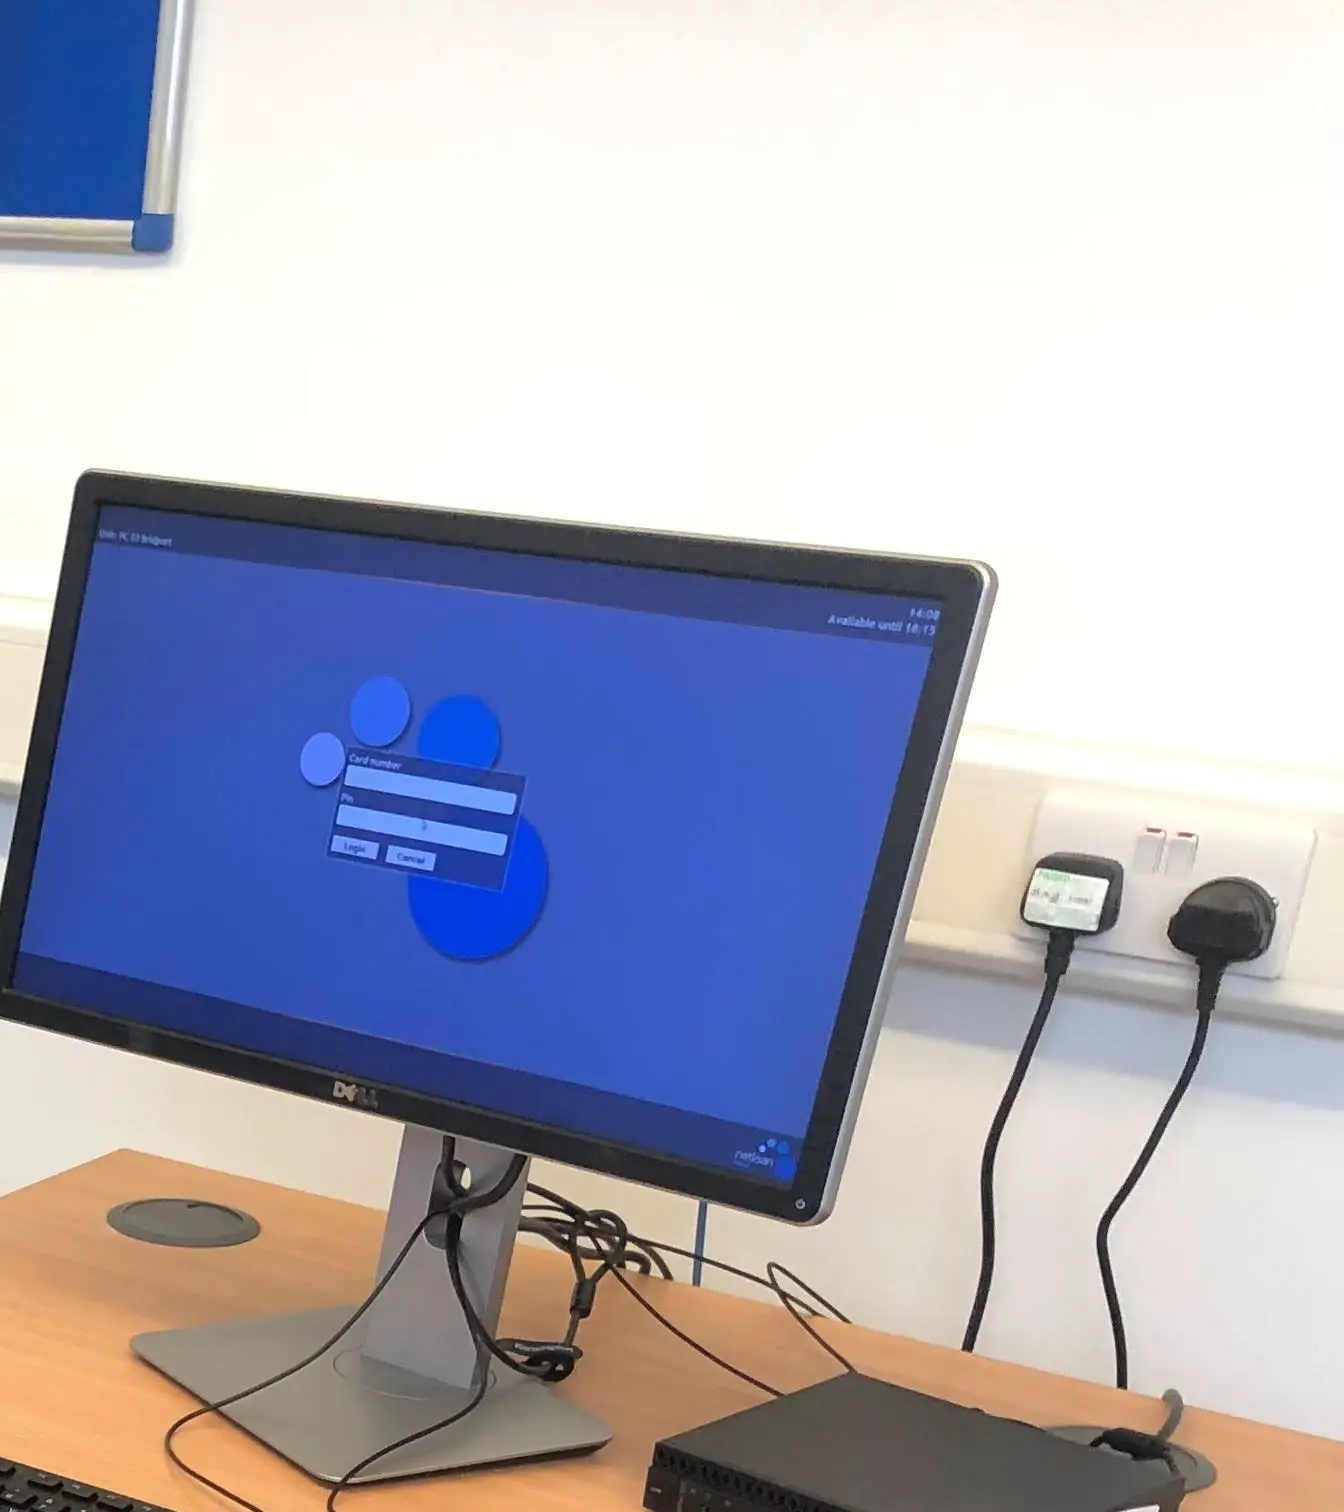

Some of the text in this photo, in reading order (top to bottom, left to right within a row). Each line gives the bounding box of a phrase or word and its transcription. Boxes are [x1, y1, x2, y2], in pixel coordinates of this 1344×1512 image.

[827, 614, 876, 630] Available
[878, 619, 903, 633] until
[348, 753, 402, 771] Card number
[333, 1080, 379, 1110] DELL
